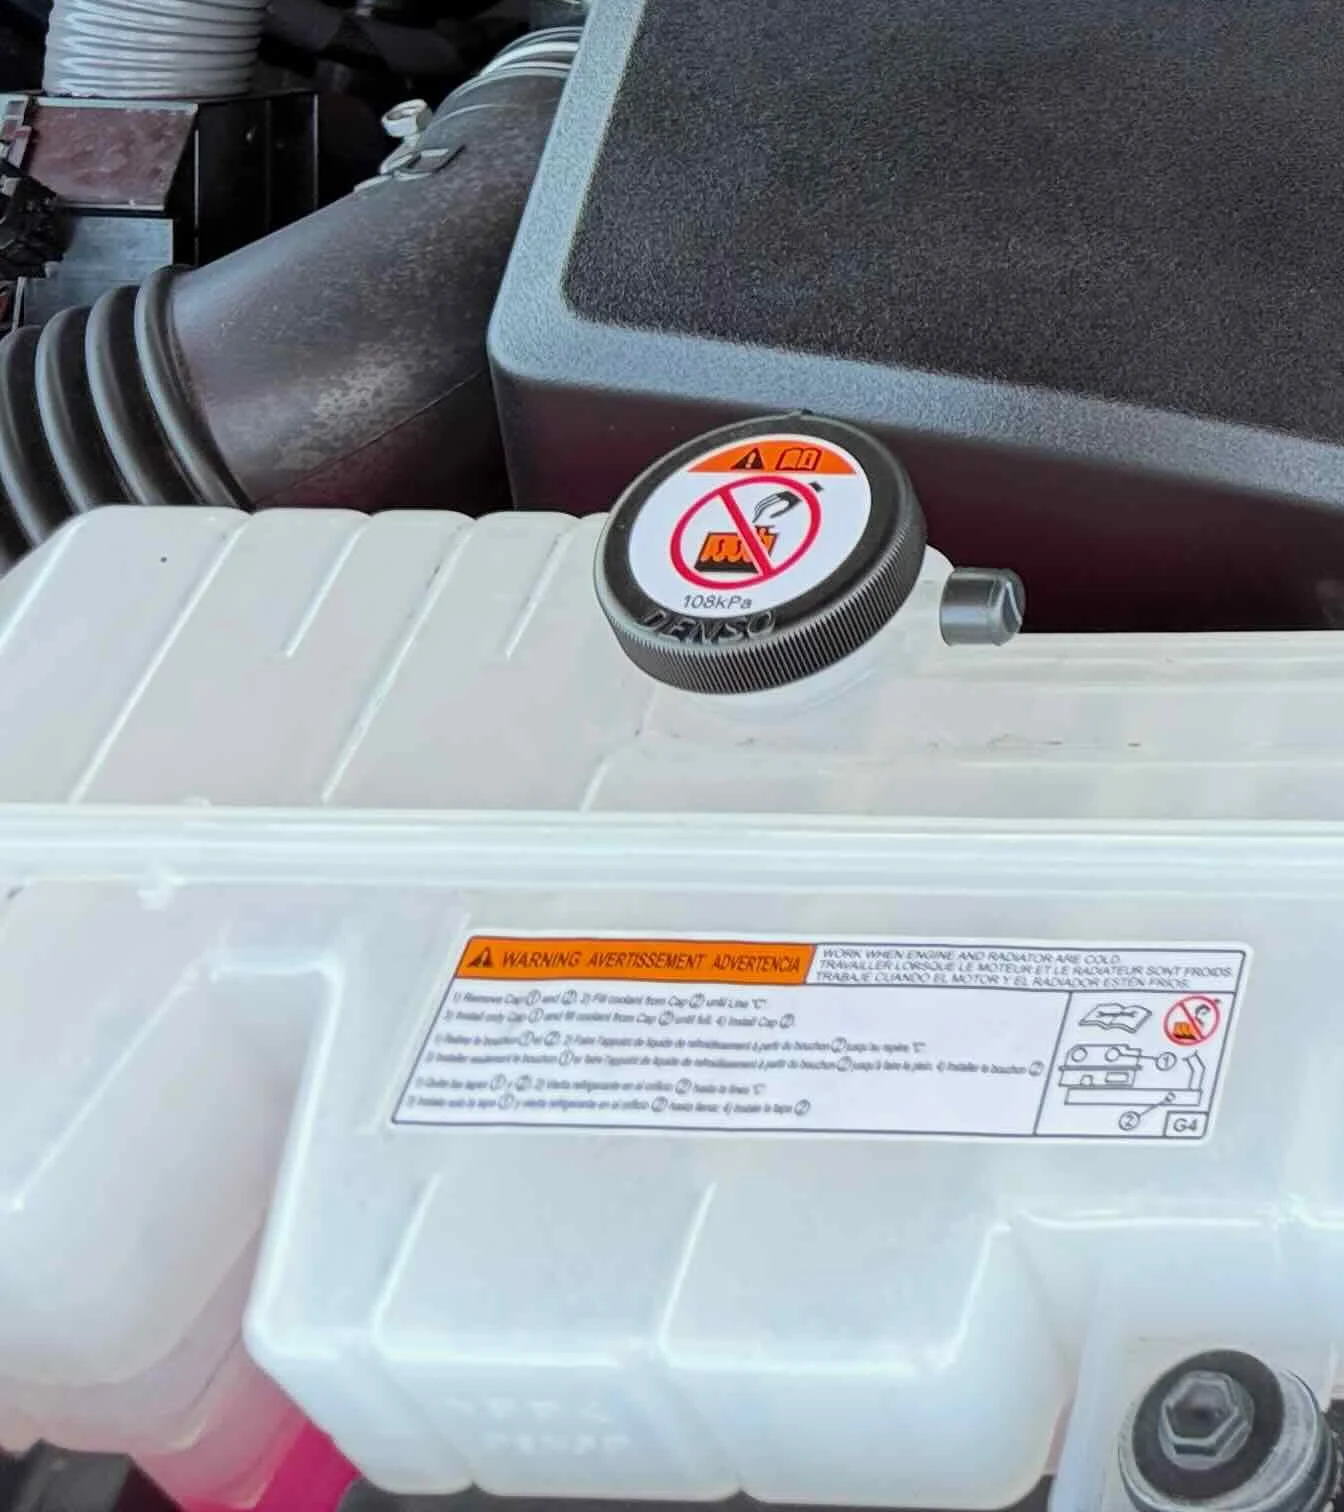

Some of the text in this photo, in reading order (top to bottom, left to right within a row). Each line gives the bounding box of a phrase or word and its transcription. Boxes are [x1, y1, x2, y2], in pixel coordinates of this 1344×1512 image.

[682, 594, 754, 610] 108kPa
[635, 608, 776, 643] DENSO
[502, 950, 801, 974] WARNING AVERTISSEMENT ADVERTENCIA
[823, 948, 861, 959] WORK
[866, 949, 905, 960] WHEN
[907, 950, 954, 961] ENGINE
[958, 951, 985, 961] AND
[988, 951, 1051, 963] RADIATOR
[1056, 953, 1081, 964] ARE
[819, 959, 894, 970] TRAVAILLER
[959, 962, 974, 972] LE
[978, 962, 1032, 974] MOTEUR
[1035, 965, 1051, 975] ET
[1055, 965, 1069, 976] LE
[1072, 966, 1143, 976] RADIATEUR
[1146, 967, 1184, 977] SONT
[816, 971, 872, 982] TRABAJE
[874, 972, 930, 983] CUANDO
[933, 973, 949, 984] EL
[952, 974, 1000, 985] MOTOR
[1013, 976, 1027, 986] EL
[1031, 976, 1099, 987] RADIADOR
[1173, 1117, 1198, 1133] G4
